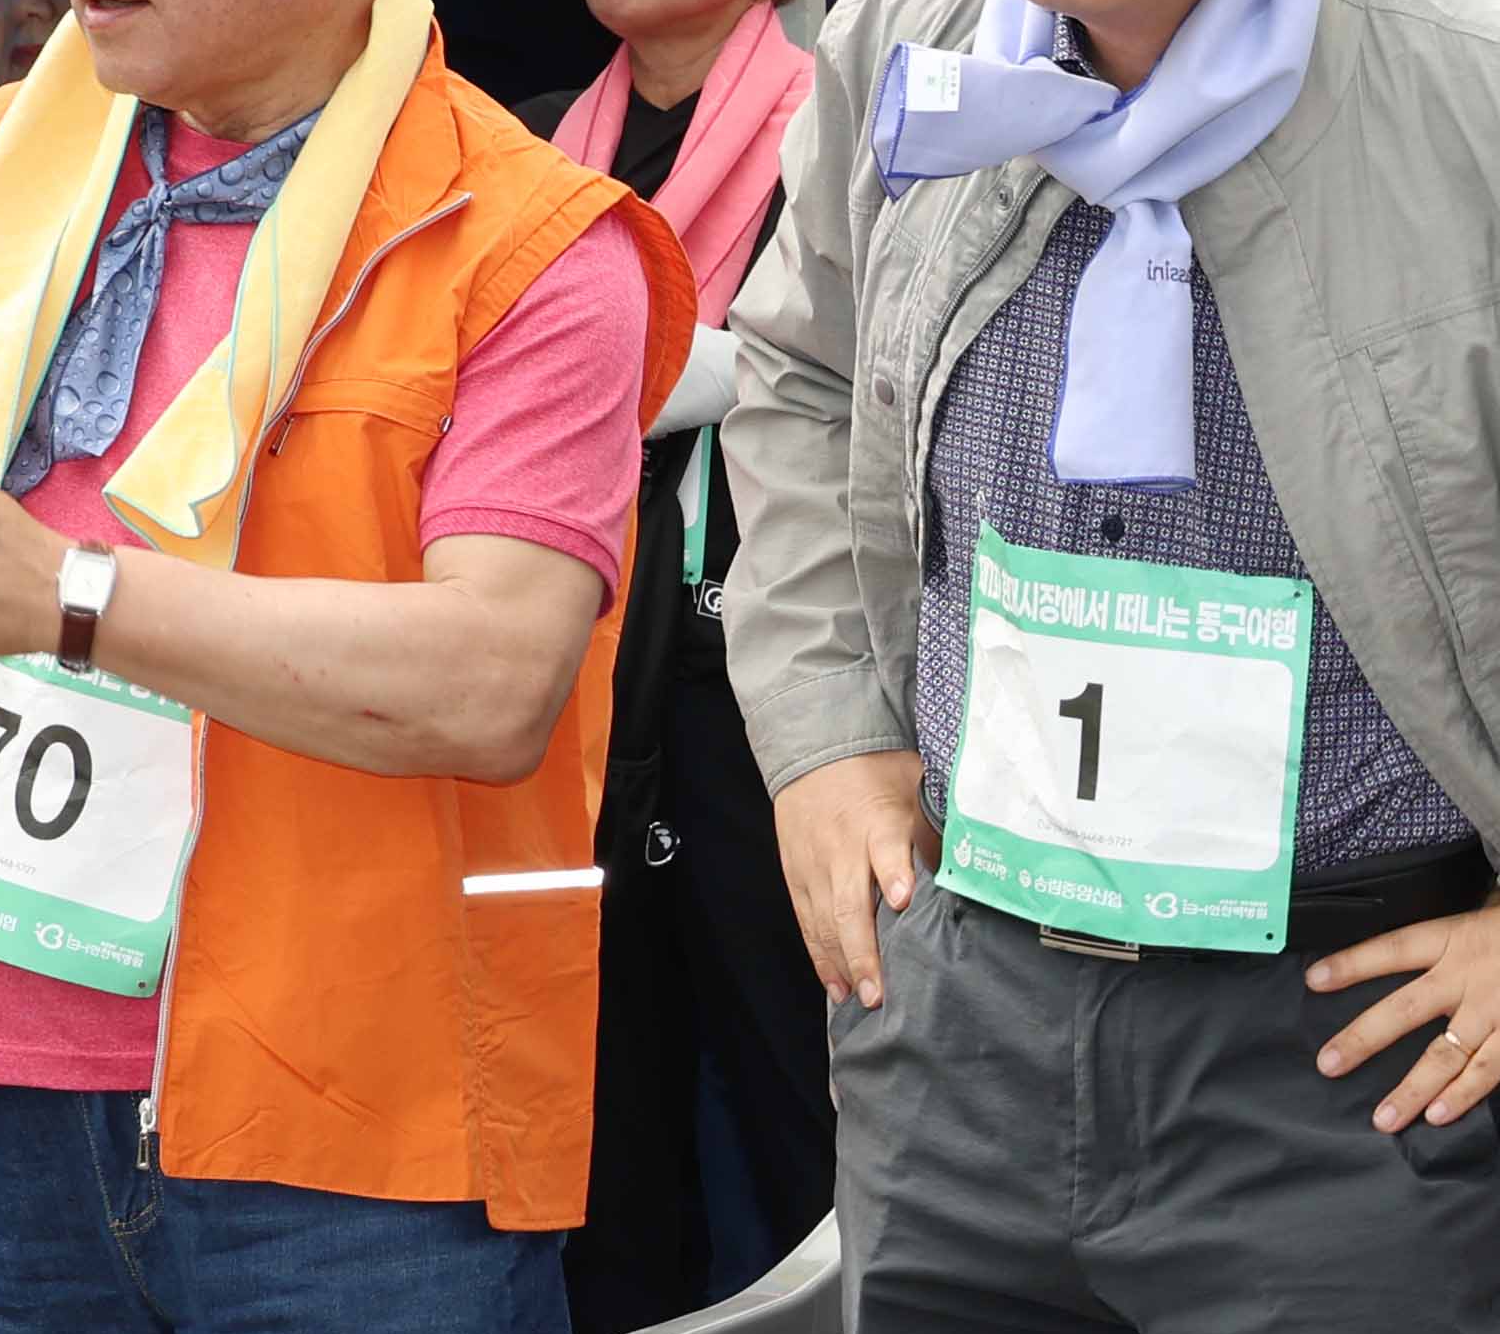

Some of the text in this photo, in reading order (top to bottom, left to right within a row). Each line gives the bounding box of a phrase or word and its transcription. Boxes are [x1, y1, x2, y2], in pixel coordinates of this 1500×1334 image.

[1115, 592, 1190, 640] 떠나는
[1196, 601, 1298, 651] 동구여행
[1059, 681, 1104, 801] 1
